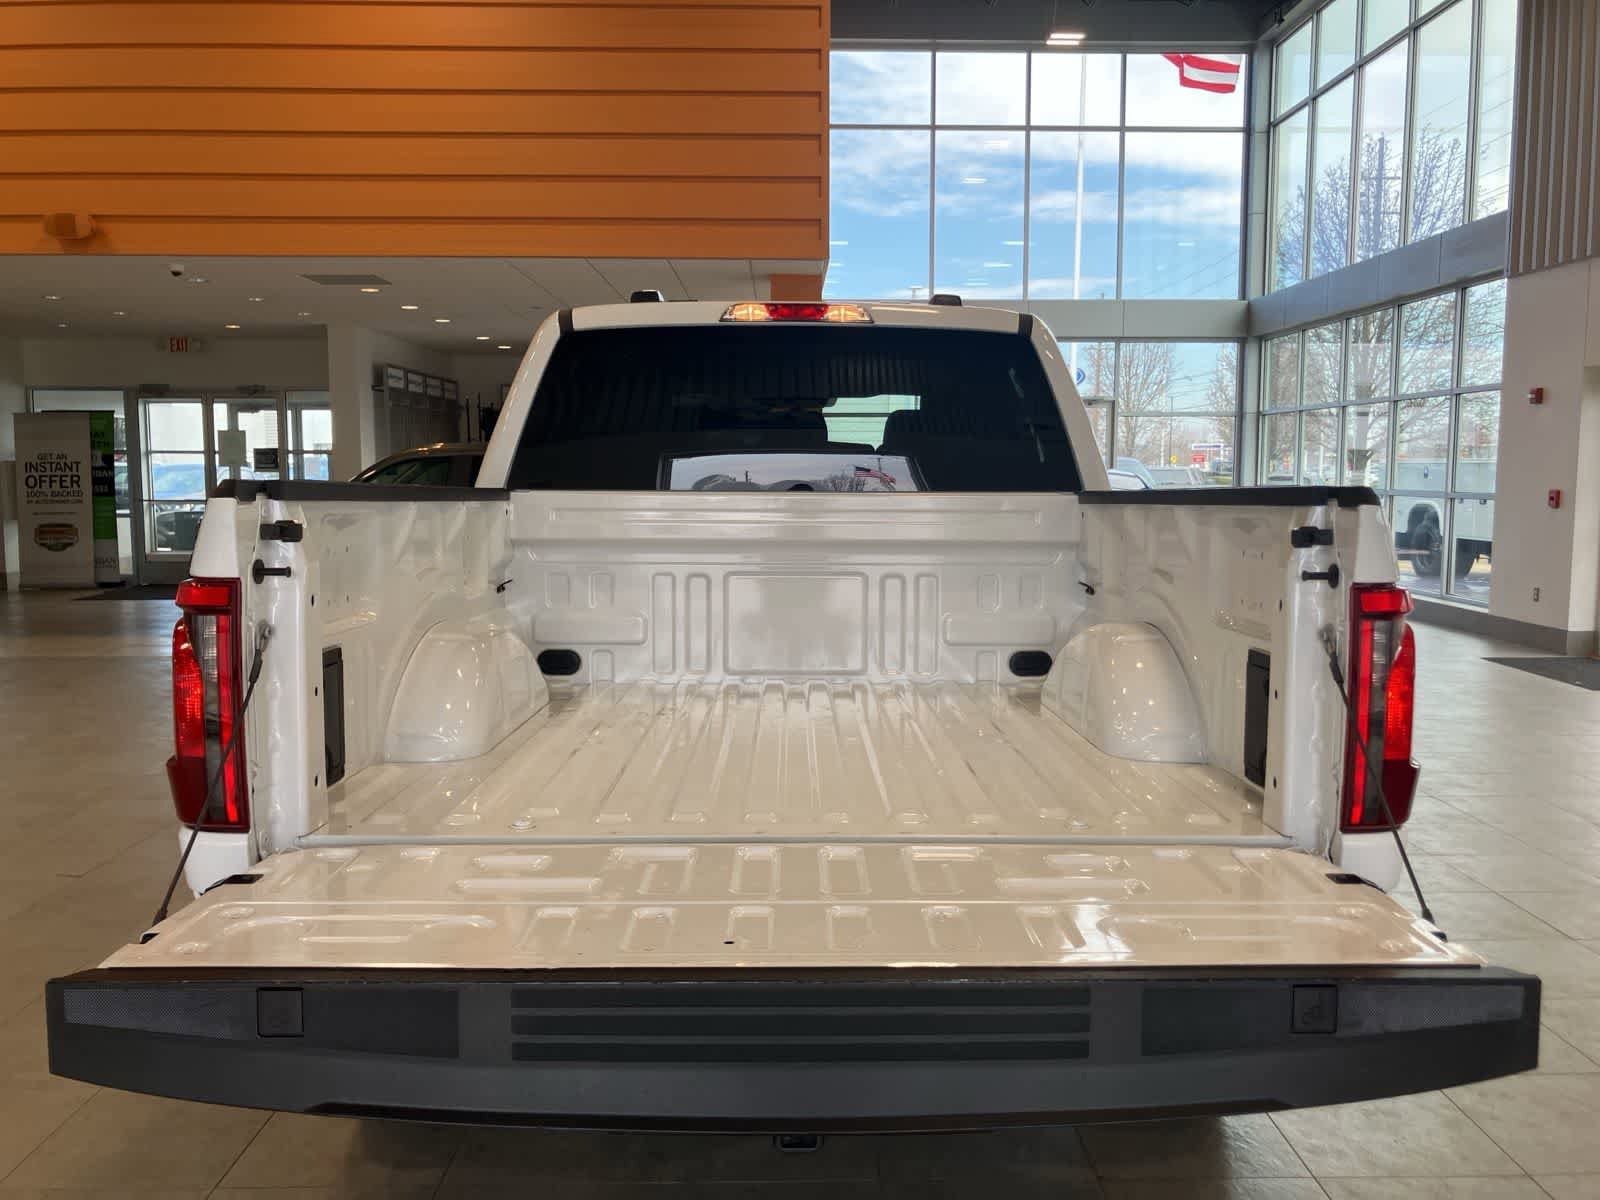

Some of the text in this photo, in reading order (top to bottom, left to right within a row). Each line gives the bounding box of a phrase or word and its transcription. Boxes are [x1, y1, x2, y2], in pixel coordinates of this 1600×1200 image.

[169, 336, 189, 353] EXIT
[37, 453, 68, 461] GET AN
[24, 461, 81, 473] INSTANT
[24, 474, 81, 489] OFFER
